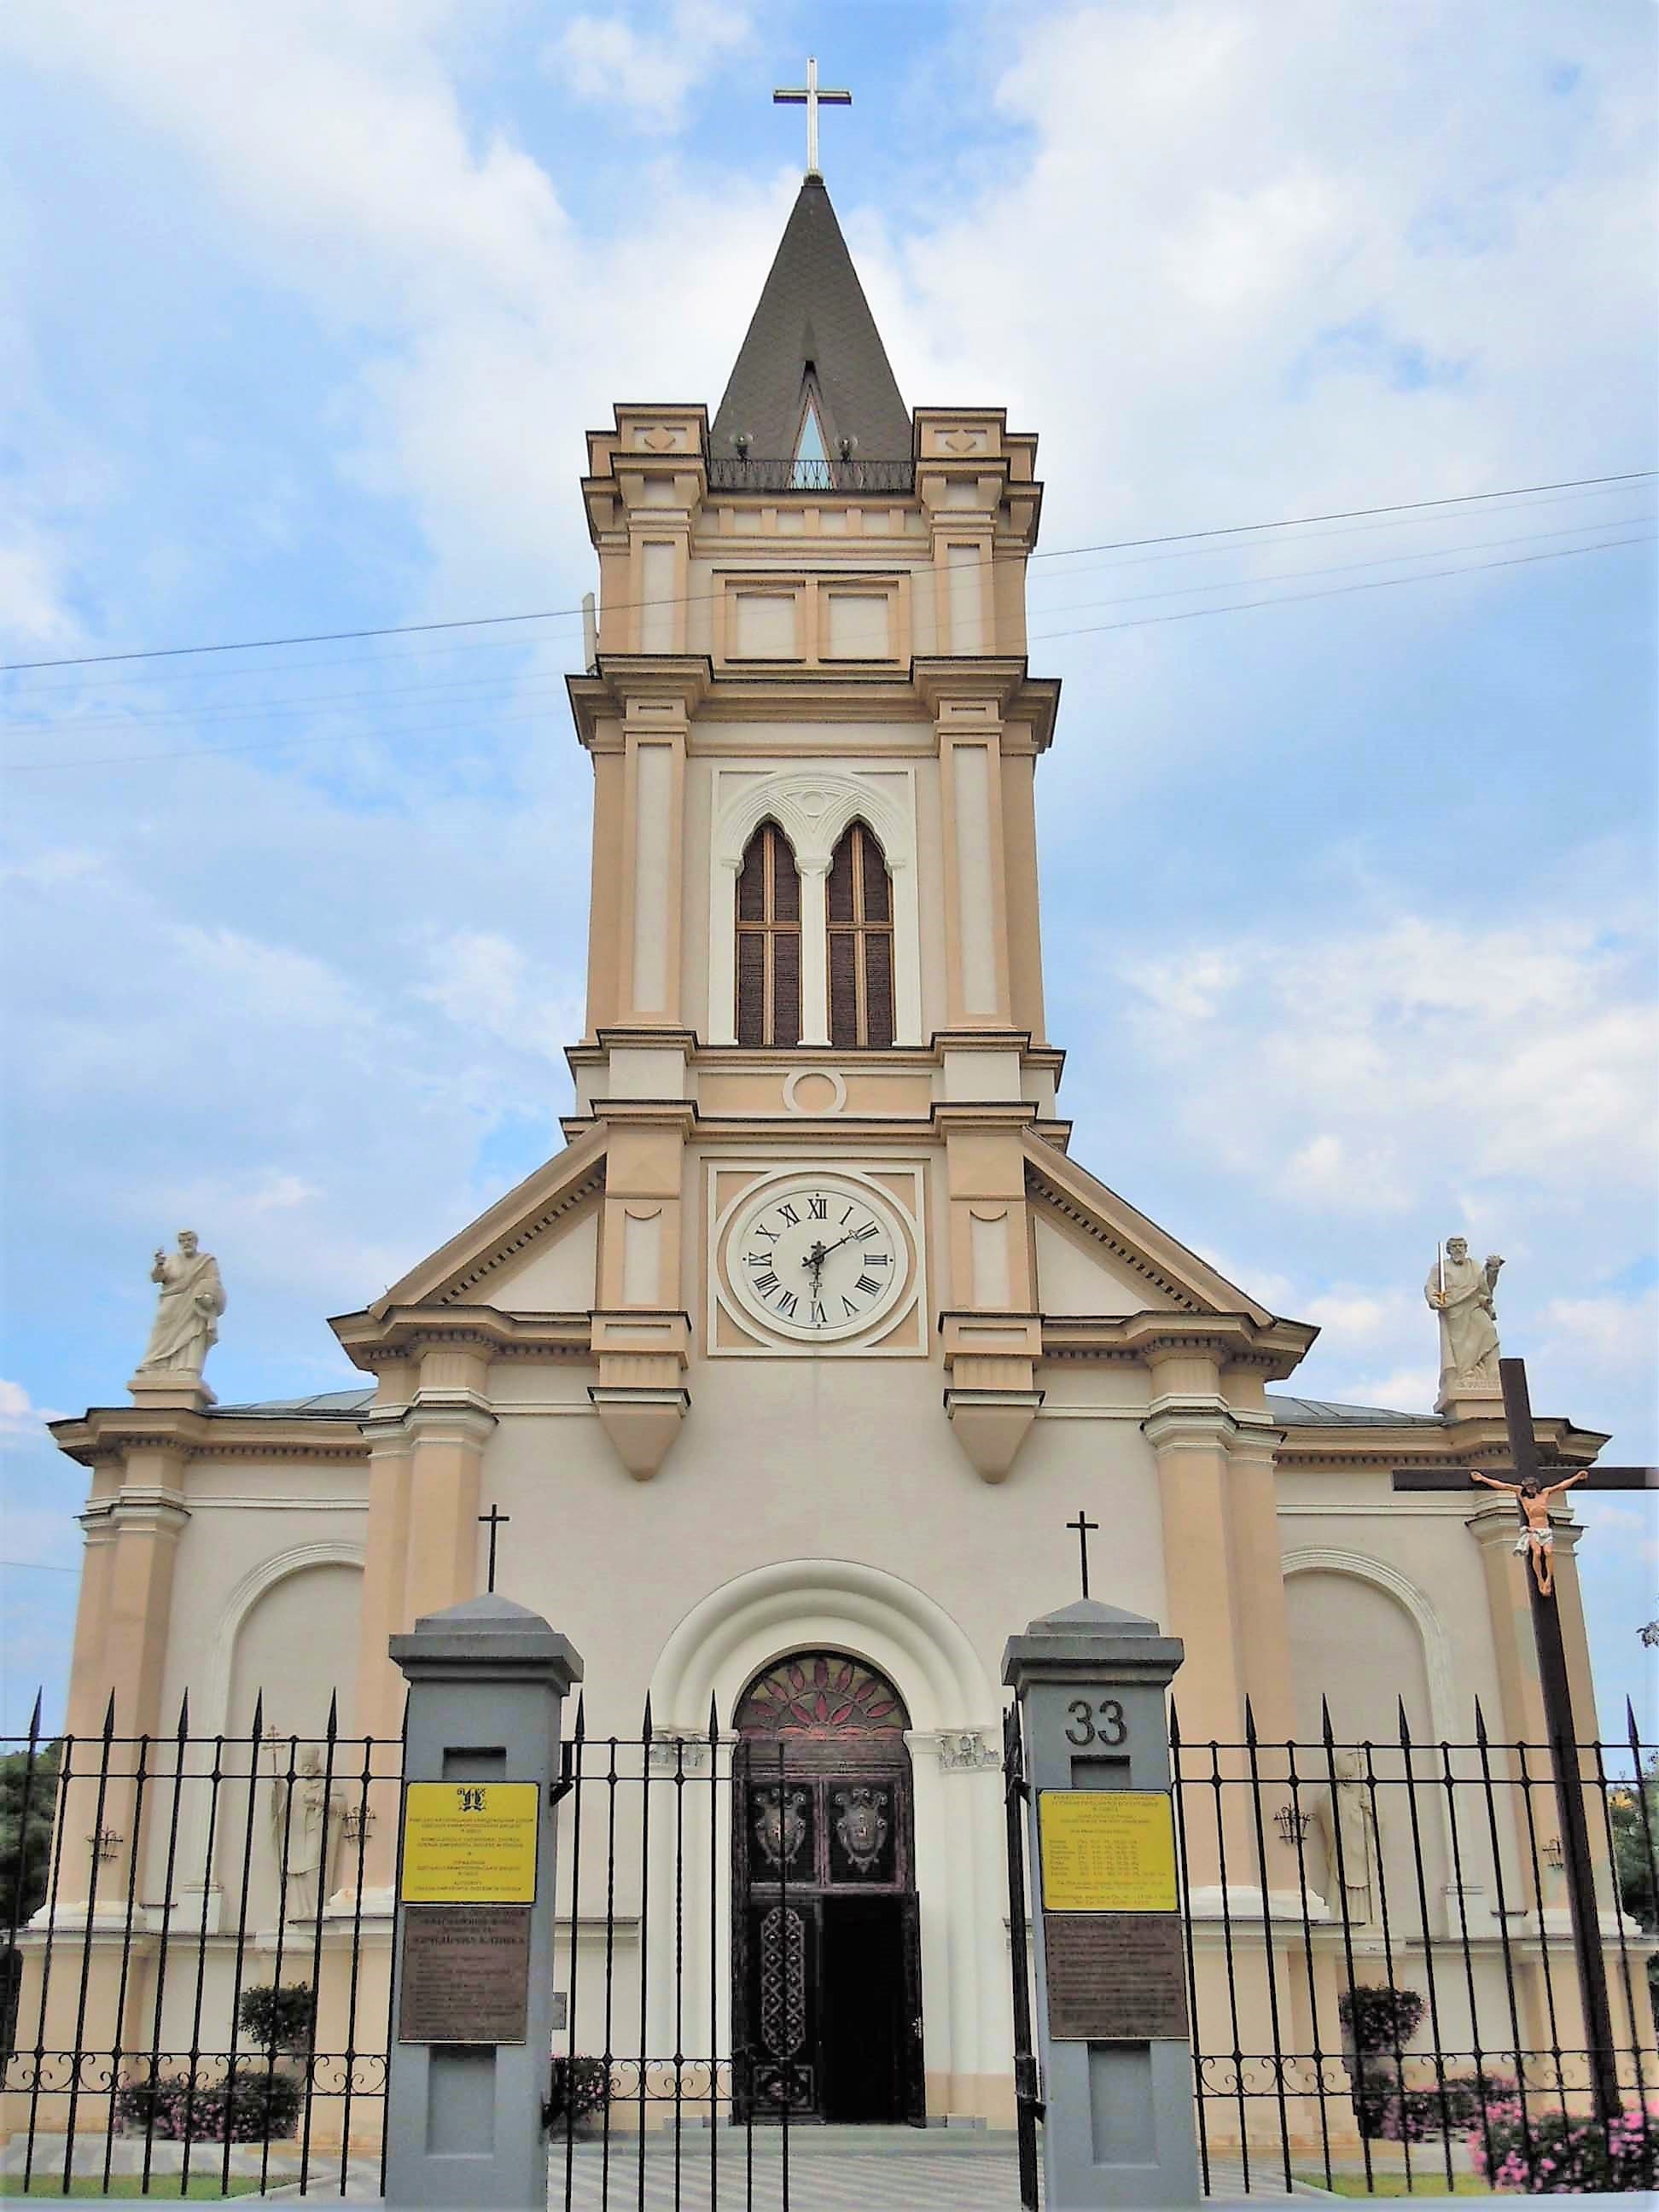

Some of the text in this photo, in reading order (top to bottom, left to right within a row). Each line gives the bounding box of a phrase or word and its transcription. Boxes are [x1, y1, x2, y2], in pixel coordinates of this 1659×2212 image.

[777, 1203, 800, 1227] XI
[807, 1199, 827, 1219] XII
[839, 1207, 854, 1225] I
[756, 1224, 781, 1243] X
[855, 1220, 880, 1242] II
[748, 1252, 771, 1266] IX
[864, 1254, 888, 1266] III
[753, 1271, 782, 1300] VIII
[854, 1274, 883, 1296] IIII
[777, 1290, 799, 1318] VII
[810, 1301, 828, 1322] VI
[841, 1295, 859, 1317] V
[1065, 1699, 1127, 1746] 33
